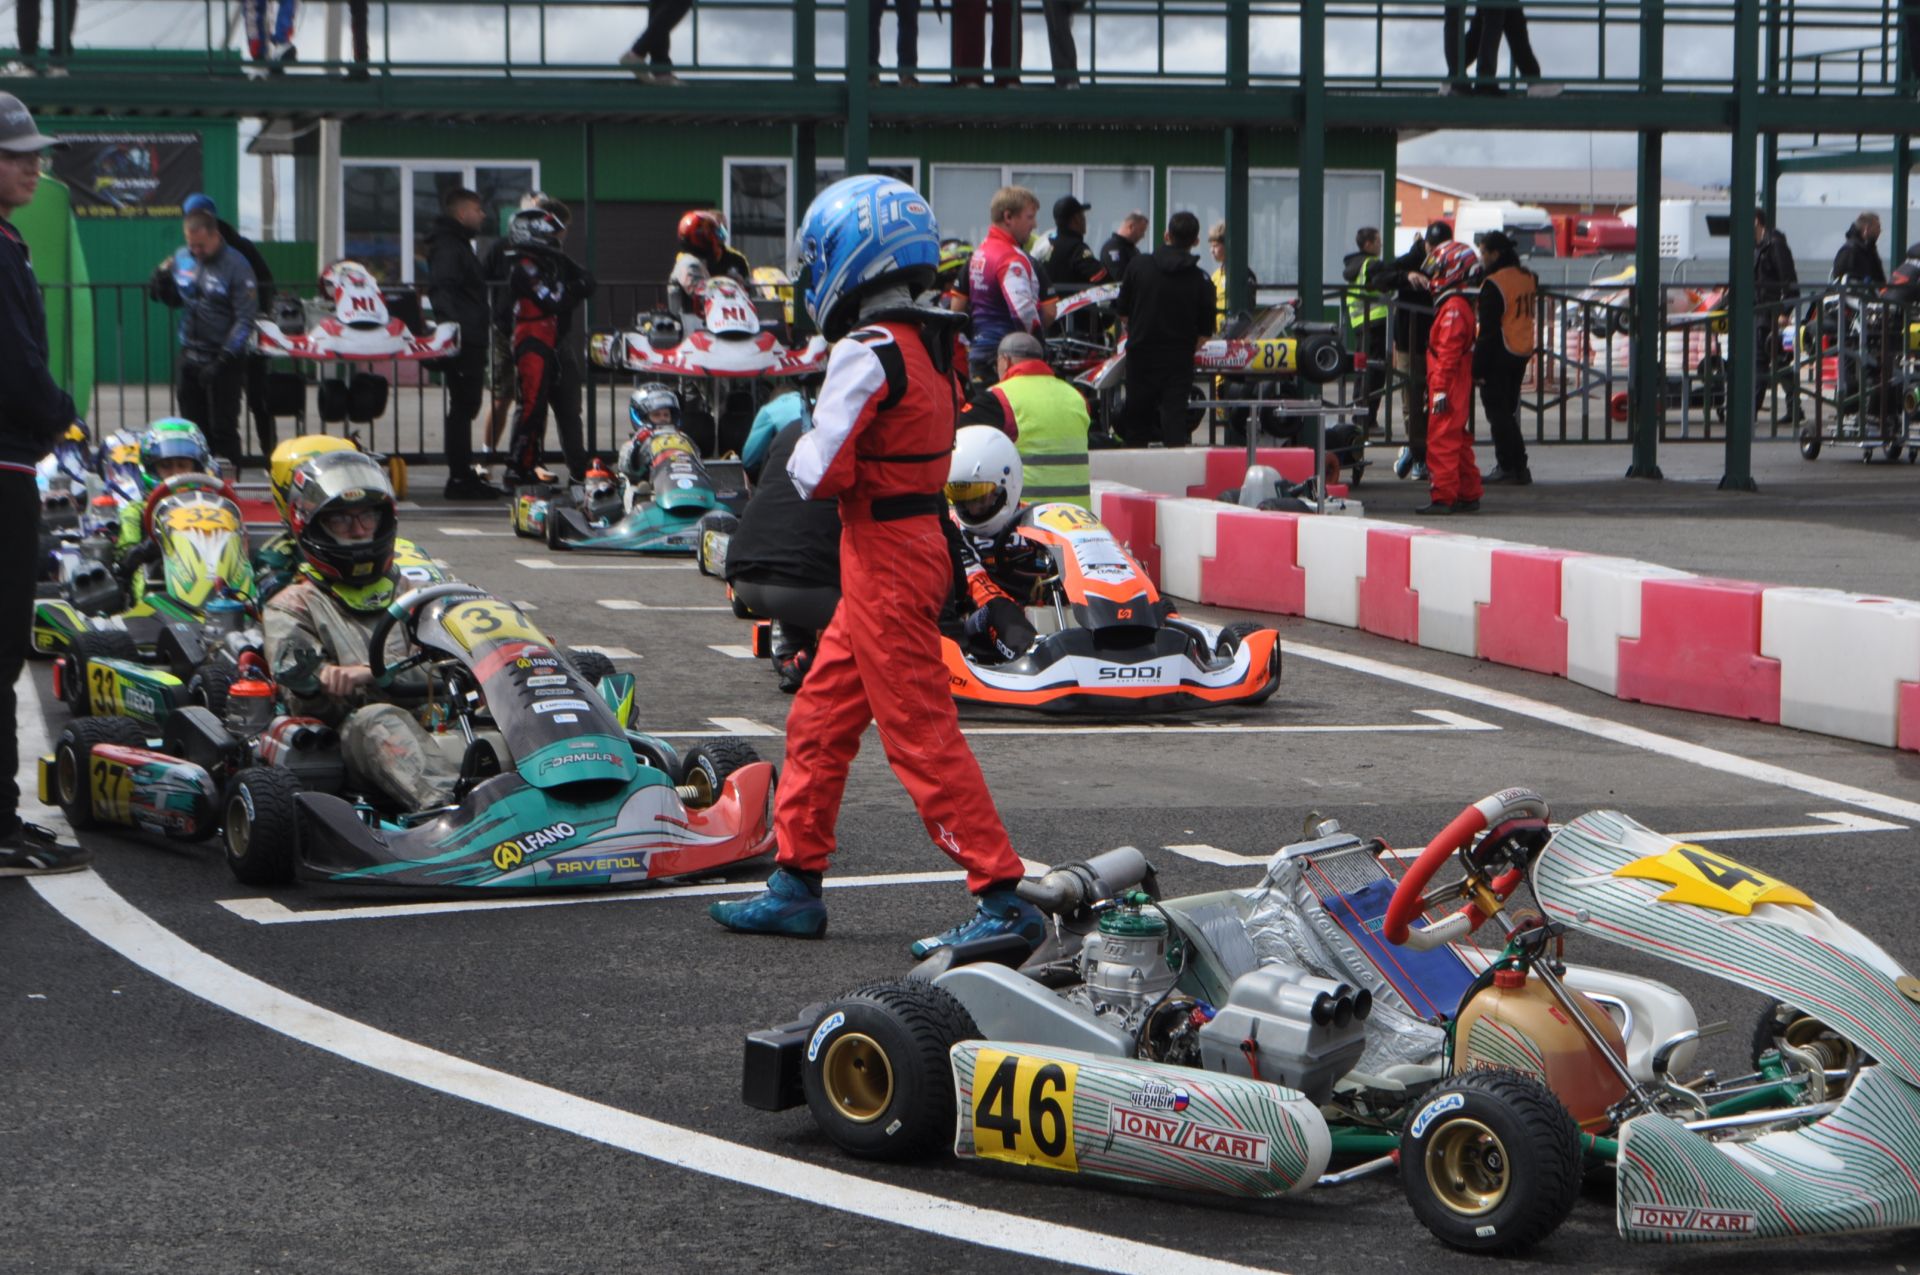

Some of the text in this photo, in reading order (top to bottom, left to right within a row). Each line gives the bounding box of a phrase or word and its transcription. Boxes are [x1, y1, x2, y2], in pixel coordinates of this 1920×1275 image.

[1264, 343, 1288, 368] 82
[187, 508, 224, 524] 32
[1057, 510, 1101, 525] 19
[461, 605, 530, 635] 37
[1098, 667, 1161, 680] SODI
[94, 760, 125, 821] 37
[493, 822, 576, 871] ALFANO
[556, 857, 641, 874] RAVENOL
[809, 1014, 842, 1057] VEGA
[975, 1055, 1067, 1158] 46
[1413, 1095, 1461, 1135] VEGA
